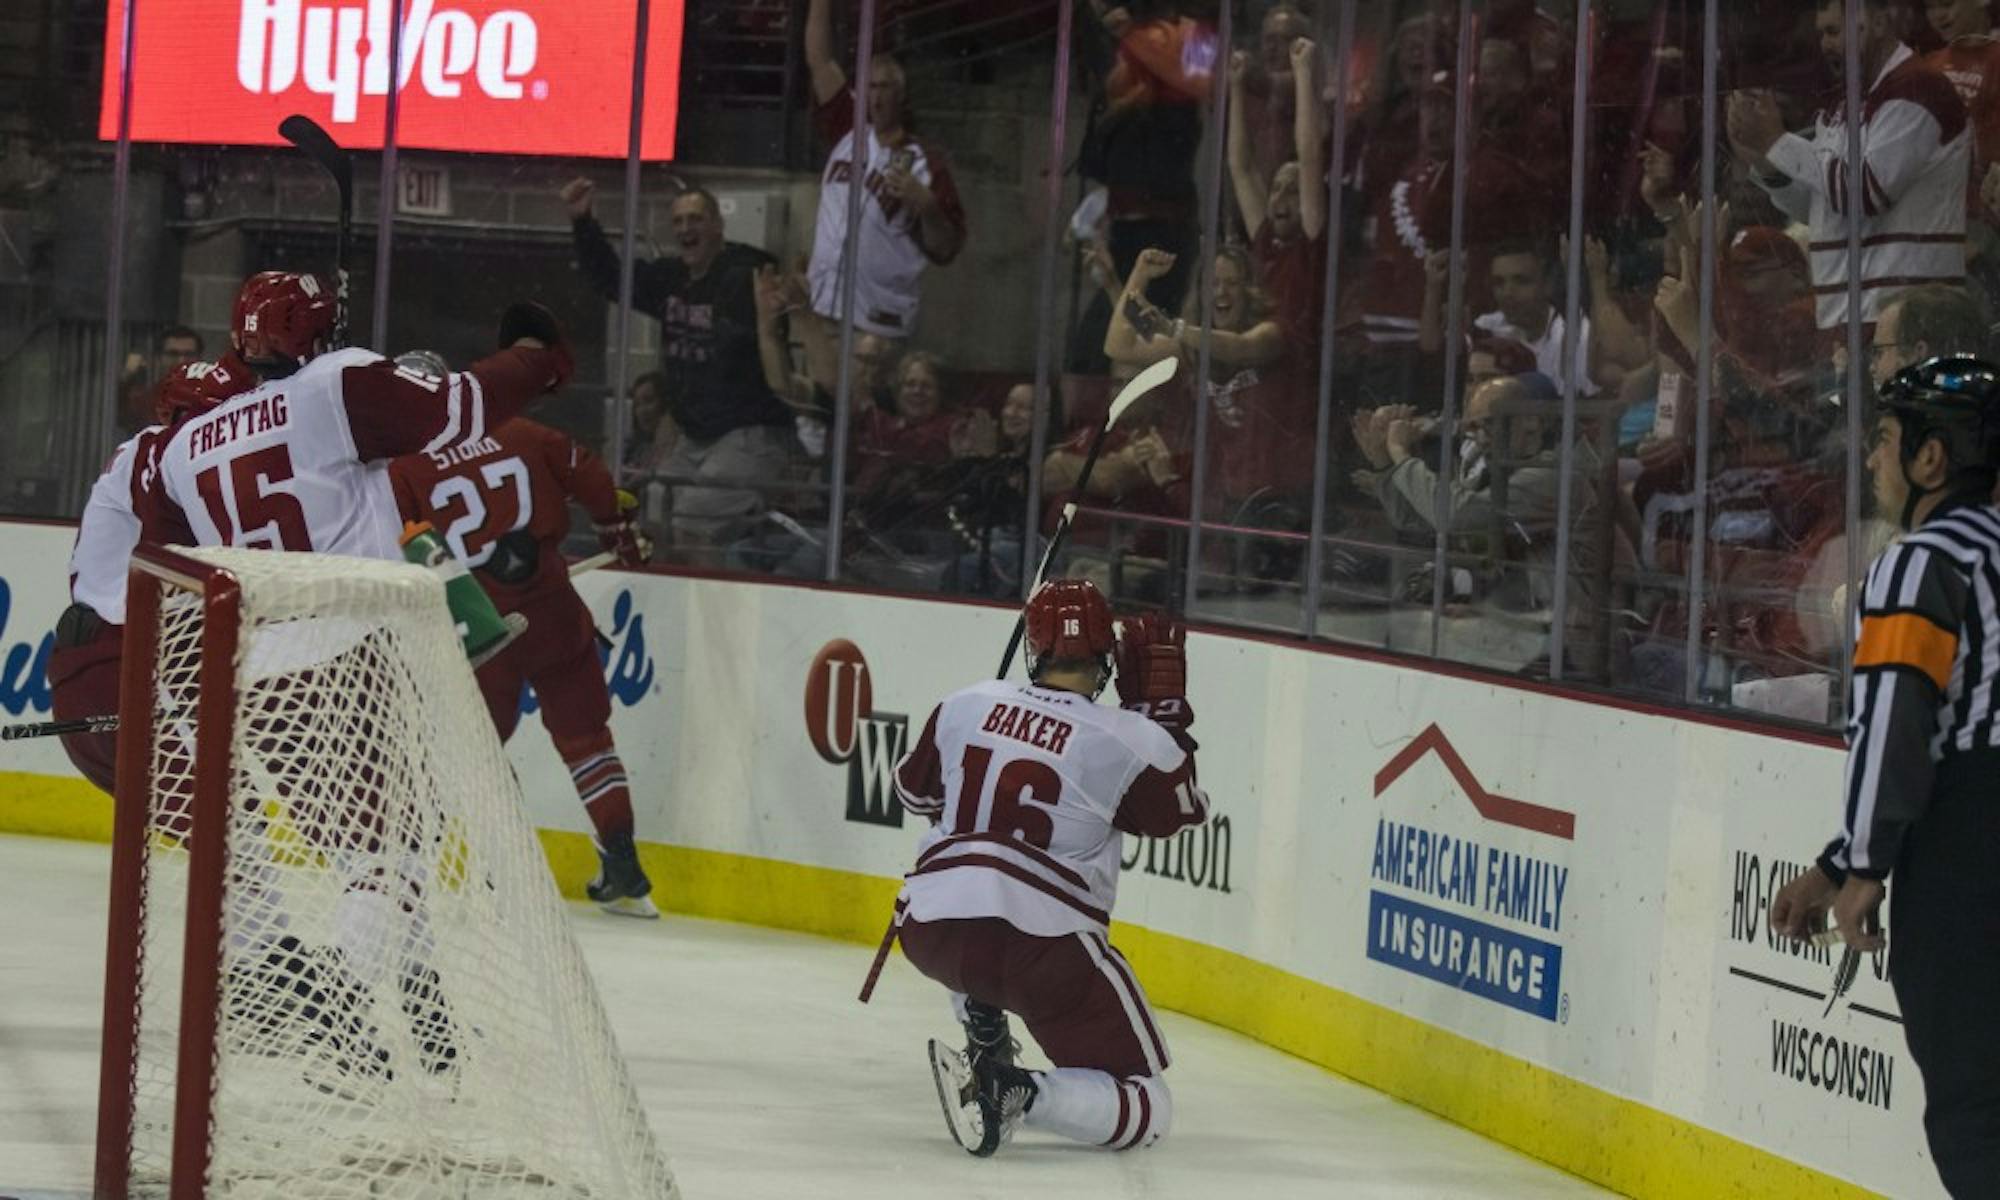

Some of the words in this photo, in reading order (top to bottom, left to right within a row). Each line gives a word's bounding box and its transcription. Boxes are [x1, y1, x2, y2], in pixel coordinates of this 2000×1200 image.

[405, 171, 439, 209] EXIT
[244, 315, 258, 331] 15
[189, 394, 288, 460] FREYTAG
[195, 442, 313, 552] 15
[430, 457, 533, 569] 27
[1063, 619, 1080, 635] 16
[982, 703, 1073, 755] BAKER
[956, 744, 1062, 850] 16
[1372, 818, 1479, 907] AMERICAN
[1485, 848, 1568, 932] FAMILY
[1379, 908, 1546, 1000] INSURANCE
[1772, 1019, 1894, 1110] WISCONSIN
